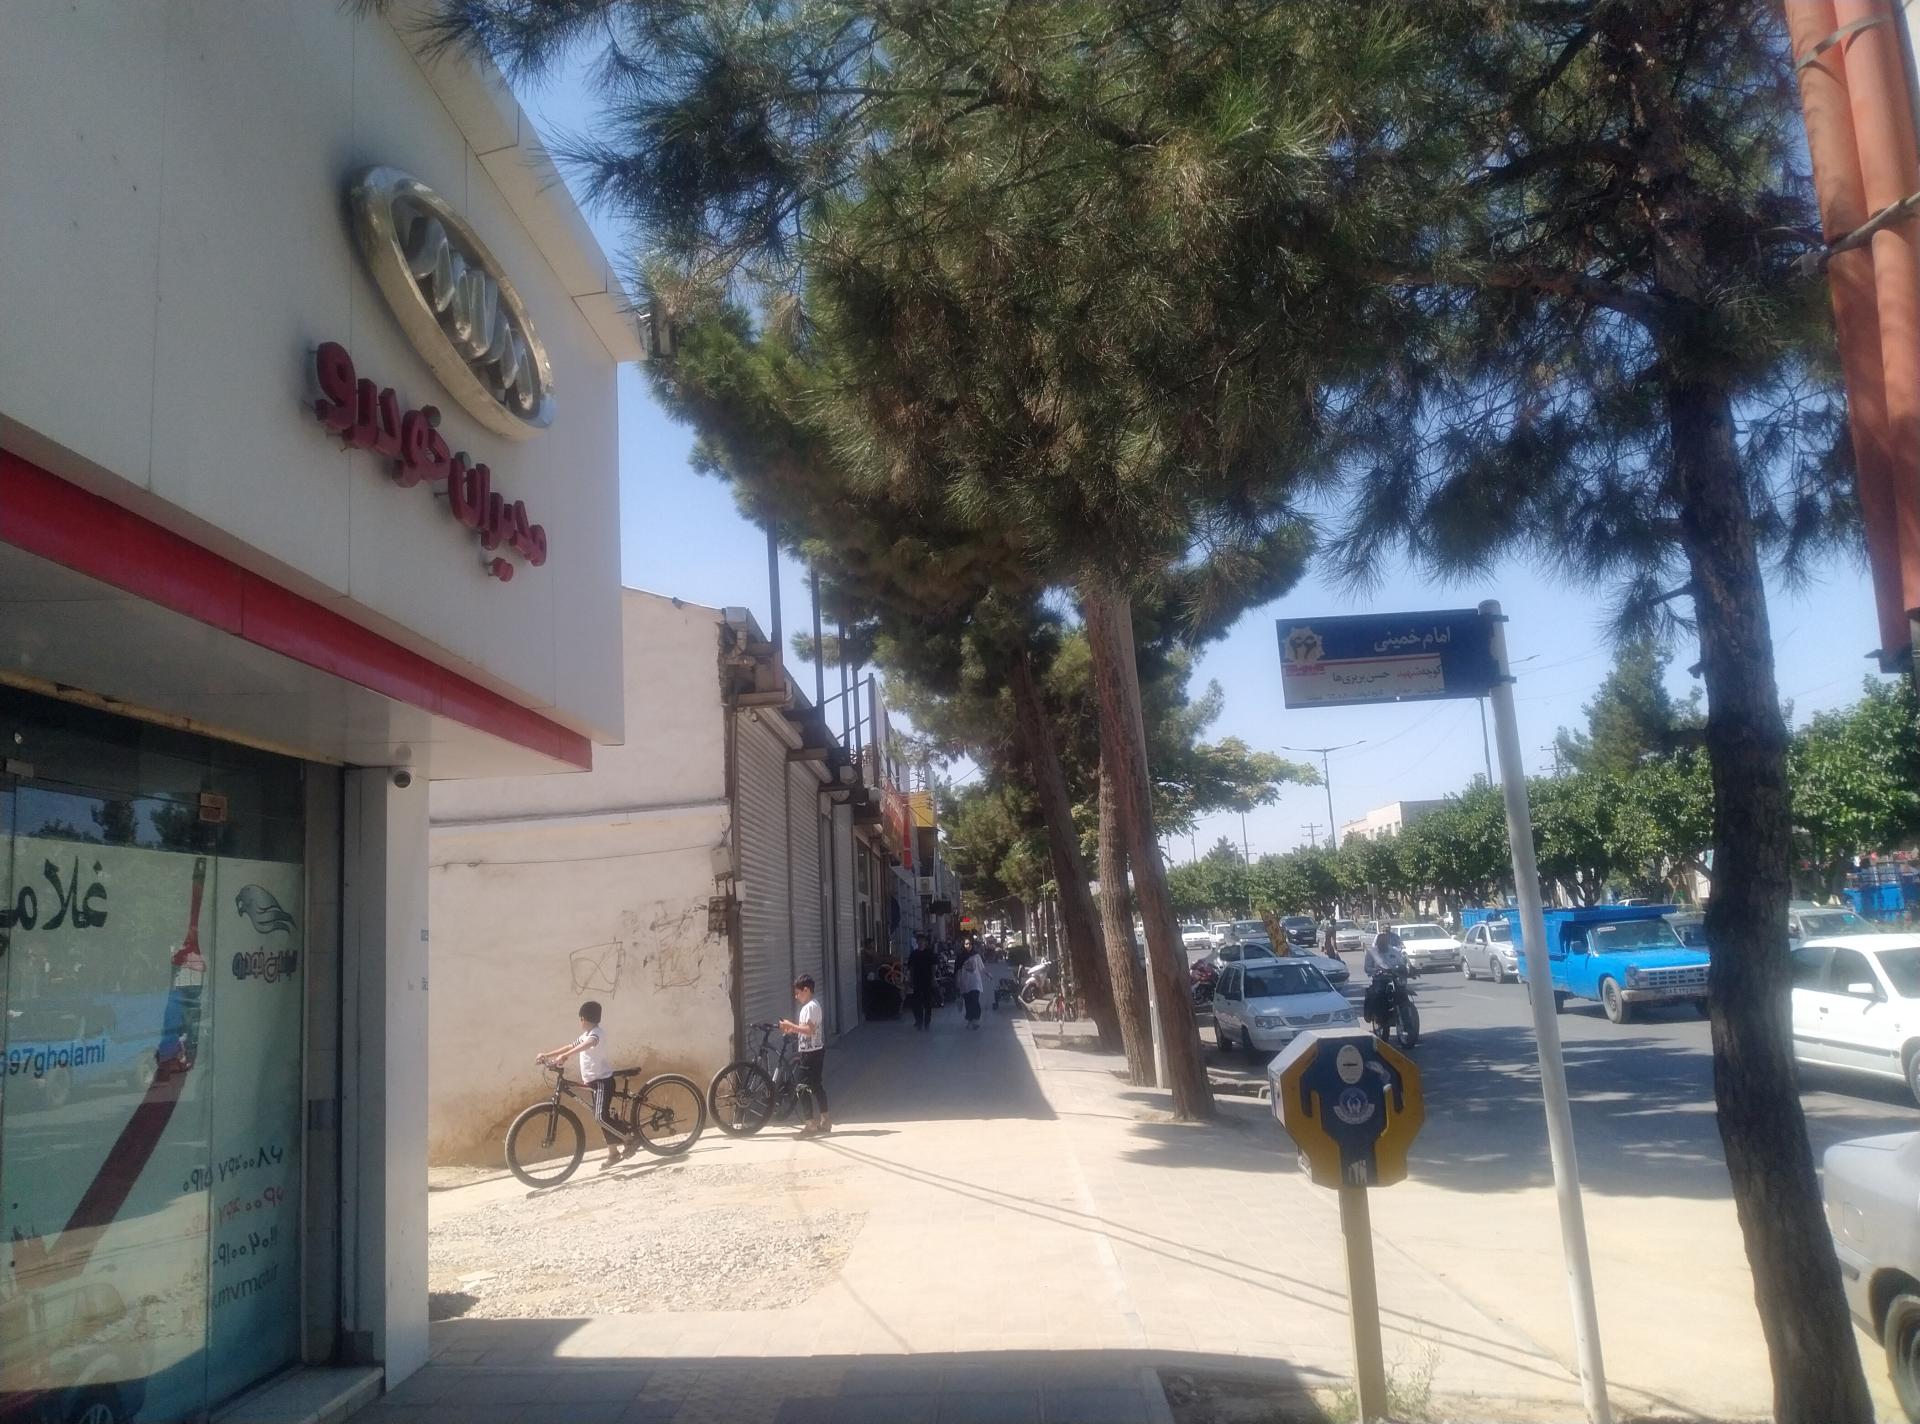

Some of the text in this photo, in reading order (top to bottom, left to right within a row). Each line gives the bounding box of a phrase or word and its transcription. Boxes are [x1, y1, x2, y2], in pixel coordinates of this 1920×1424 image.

[315, 341, 450, 488] خودرو
[1374, 625, 1451, 652] امام خمینی
